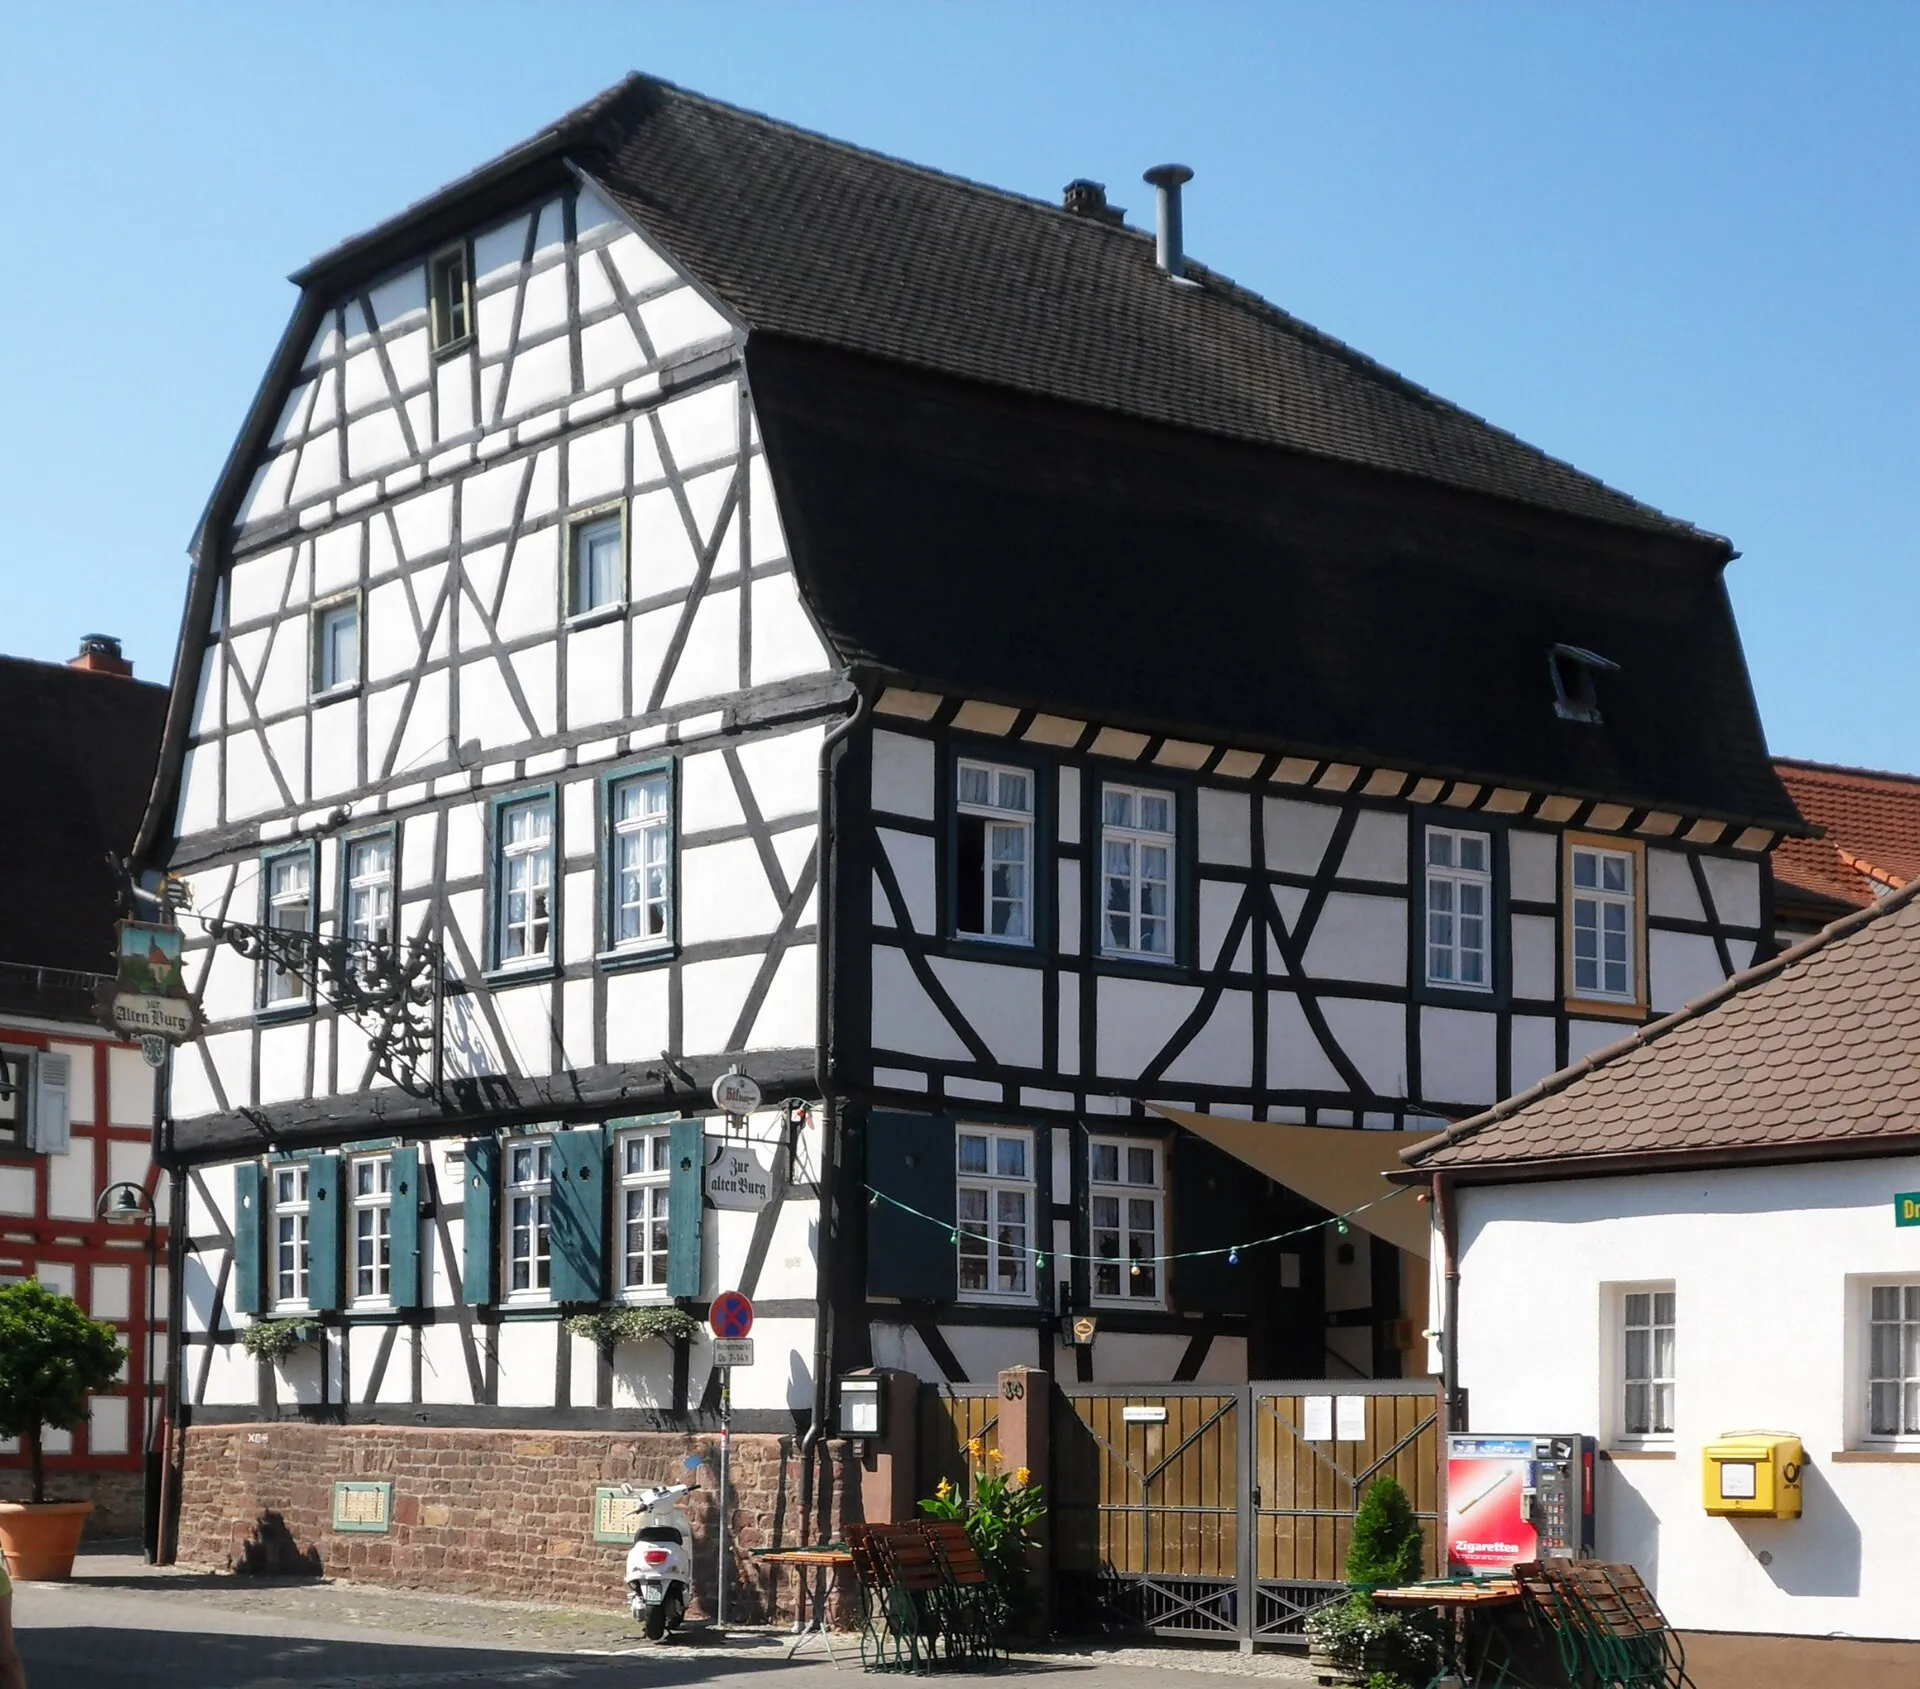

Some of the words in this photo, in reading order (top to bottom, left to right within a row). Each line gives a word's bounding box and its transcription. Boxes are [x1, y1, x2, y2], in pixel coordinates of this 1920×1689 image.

[116, 1005, 149, 1024] Alten
[151, 1009, 186, 1031] Burg
[729, 1157, 750, 1176] Zur
[711, 1176, 736, 1193] alten
[737, 1177, 767, 1199] Burg
[1456, 1540, 1520, 1554] Zigaretten
